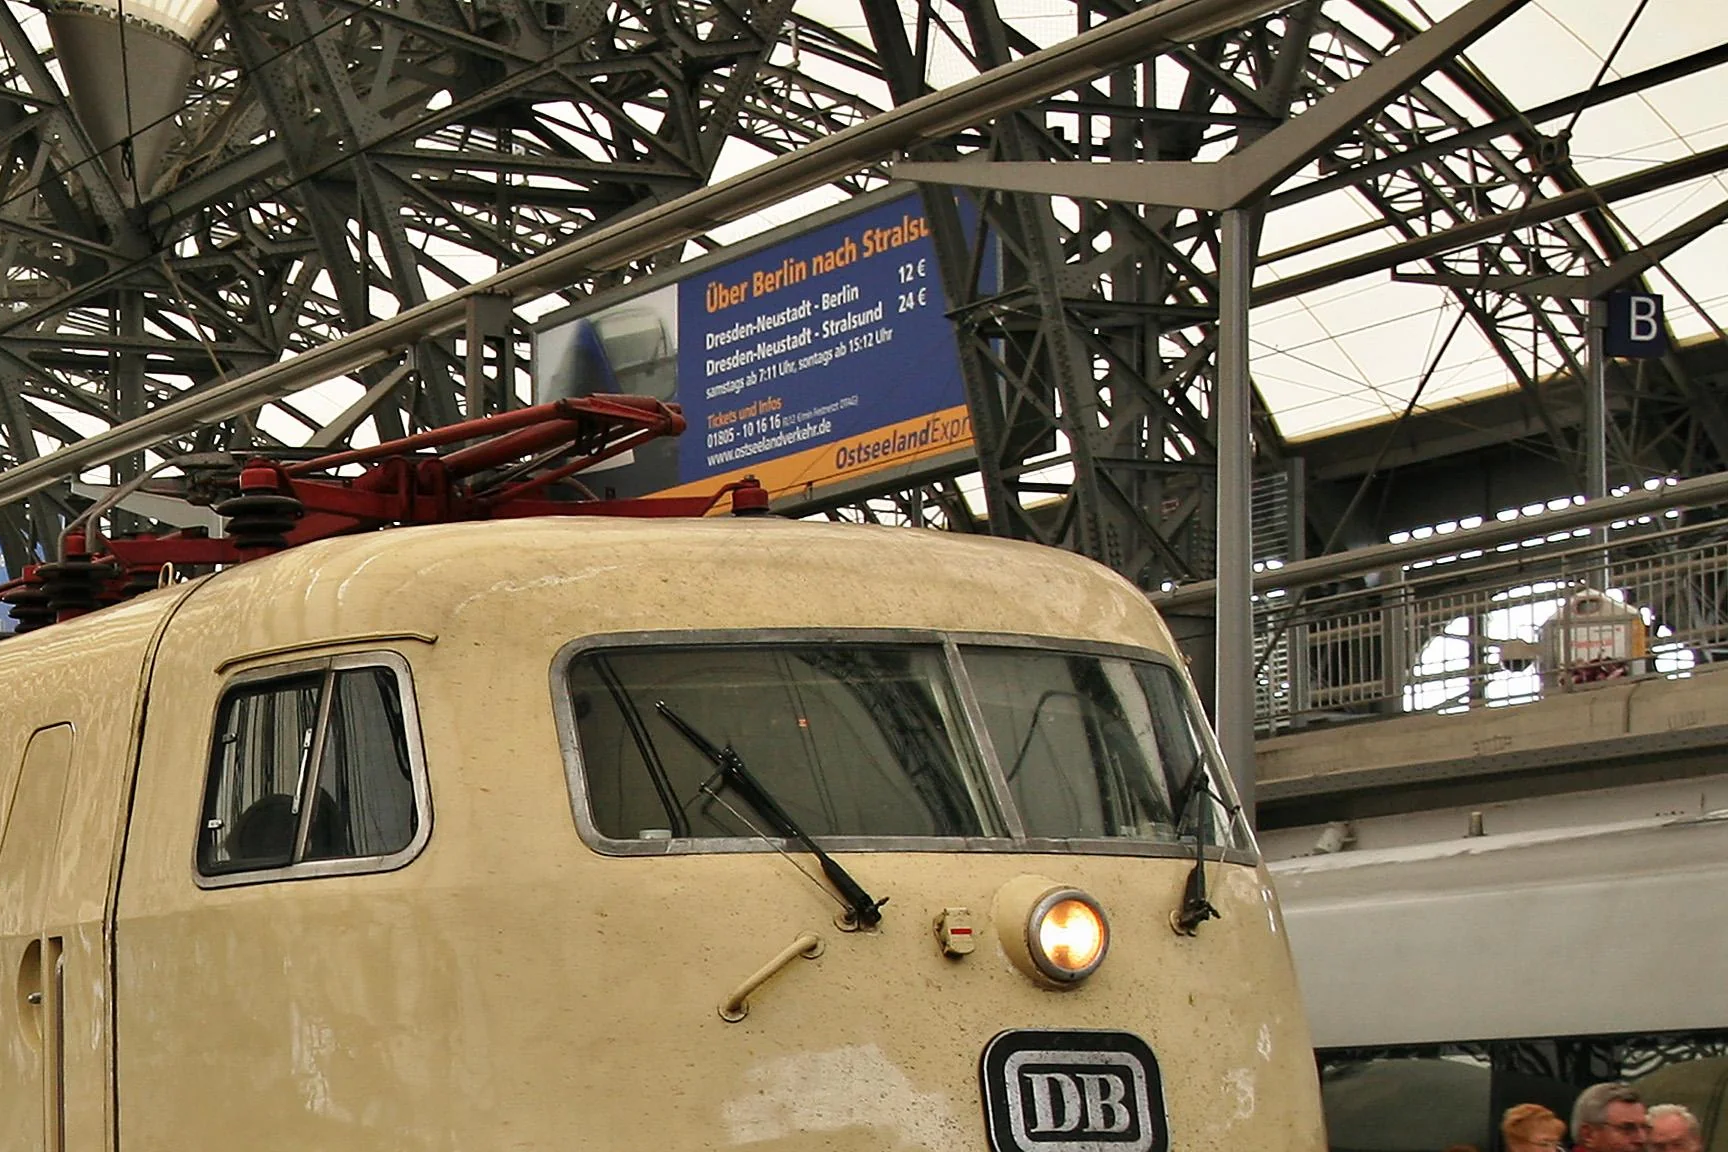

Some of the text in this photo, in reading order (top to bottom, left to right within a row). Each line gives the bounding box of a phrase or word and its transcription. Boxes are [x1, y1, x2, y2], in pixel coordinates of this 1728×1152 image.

[705, 278, 748, 313] Über
[752, 257, 807, 298] Berlin
[812, 236, 857, 275] nach
[706, 299, 812, 350] Dresden-Neustadt
[822, 284, 859, 311] Berlin
[898, 263, 914, 284] 12
[917, 258, 926, 278] €
[706, 327, 812, 377] Dresden-Neustadt
[822, 301, 883, 339] Stralsund
[898, 294, 914, 314] 24
[917, 287, 927, 307] €
[1630, 296, 1657, 341] B
[706, 376, 745, 399] samstags
[746, 372, 758, 387] ab
[759, 365, 777, 383] 7:11
[834, 343, 846, 358] ab
[848, 333, 874, 353] 15:12
[875, 327, 893, 344] Uhr
[706, 417, 832, 467] www.ostseelandverkehr.de
[707, 396, 783, 429] Tickets und Infos
[707, 427, 735, 449] 01805
[743, 421, 754, 438] 10
[756, 417, 768, 433] 16
[770, 414, 781, 429] 16
[1022, 1072, 1131, 1134] DB
